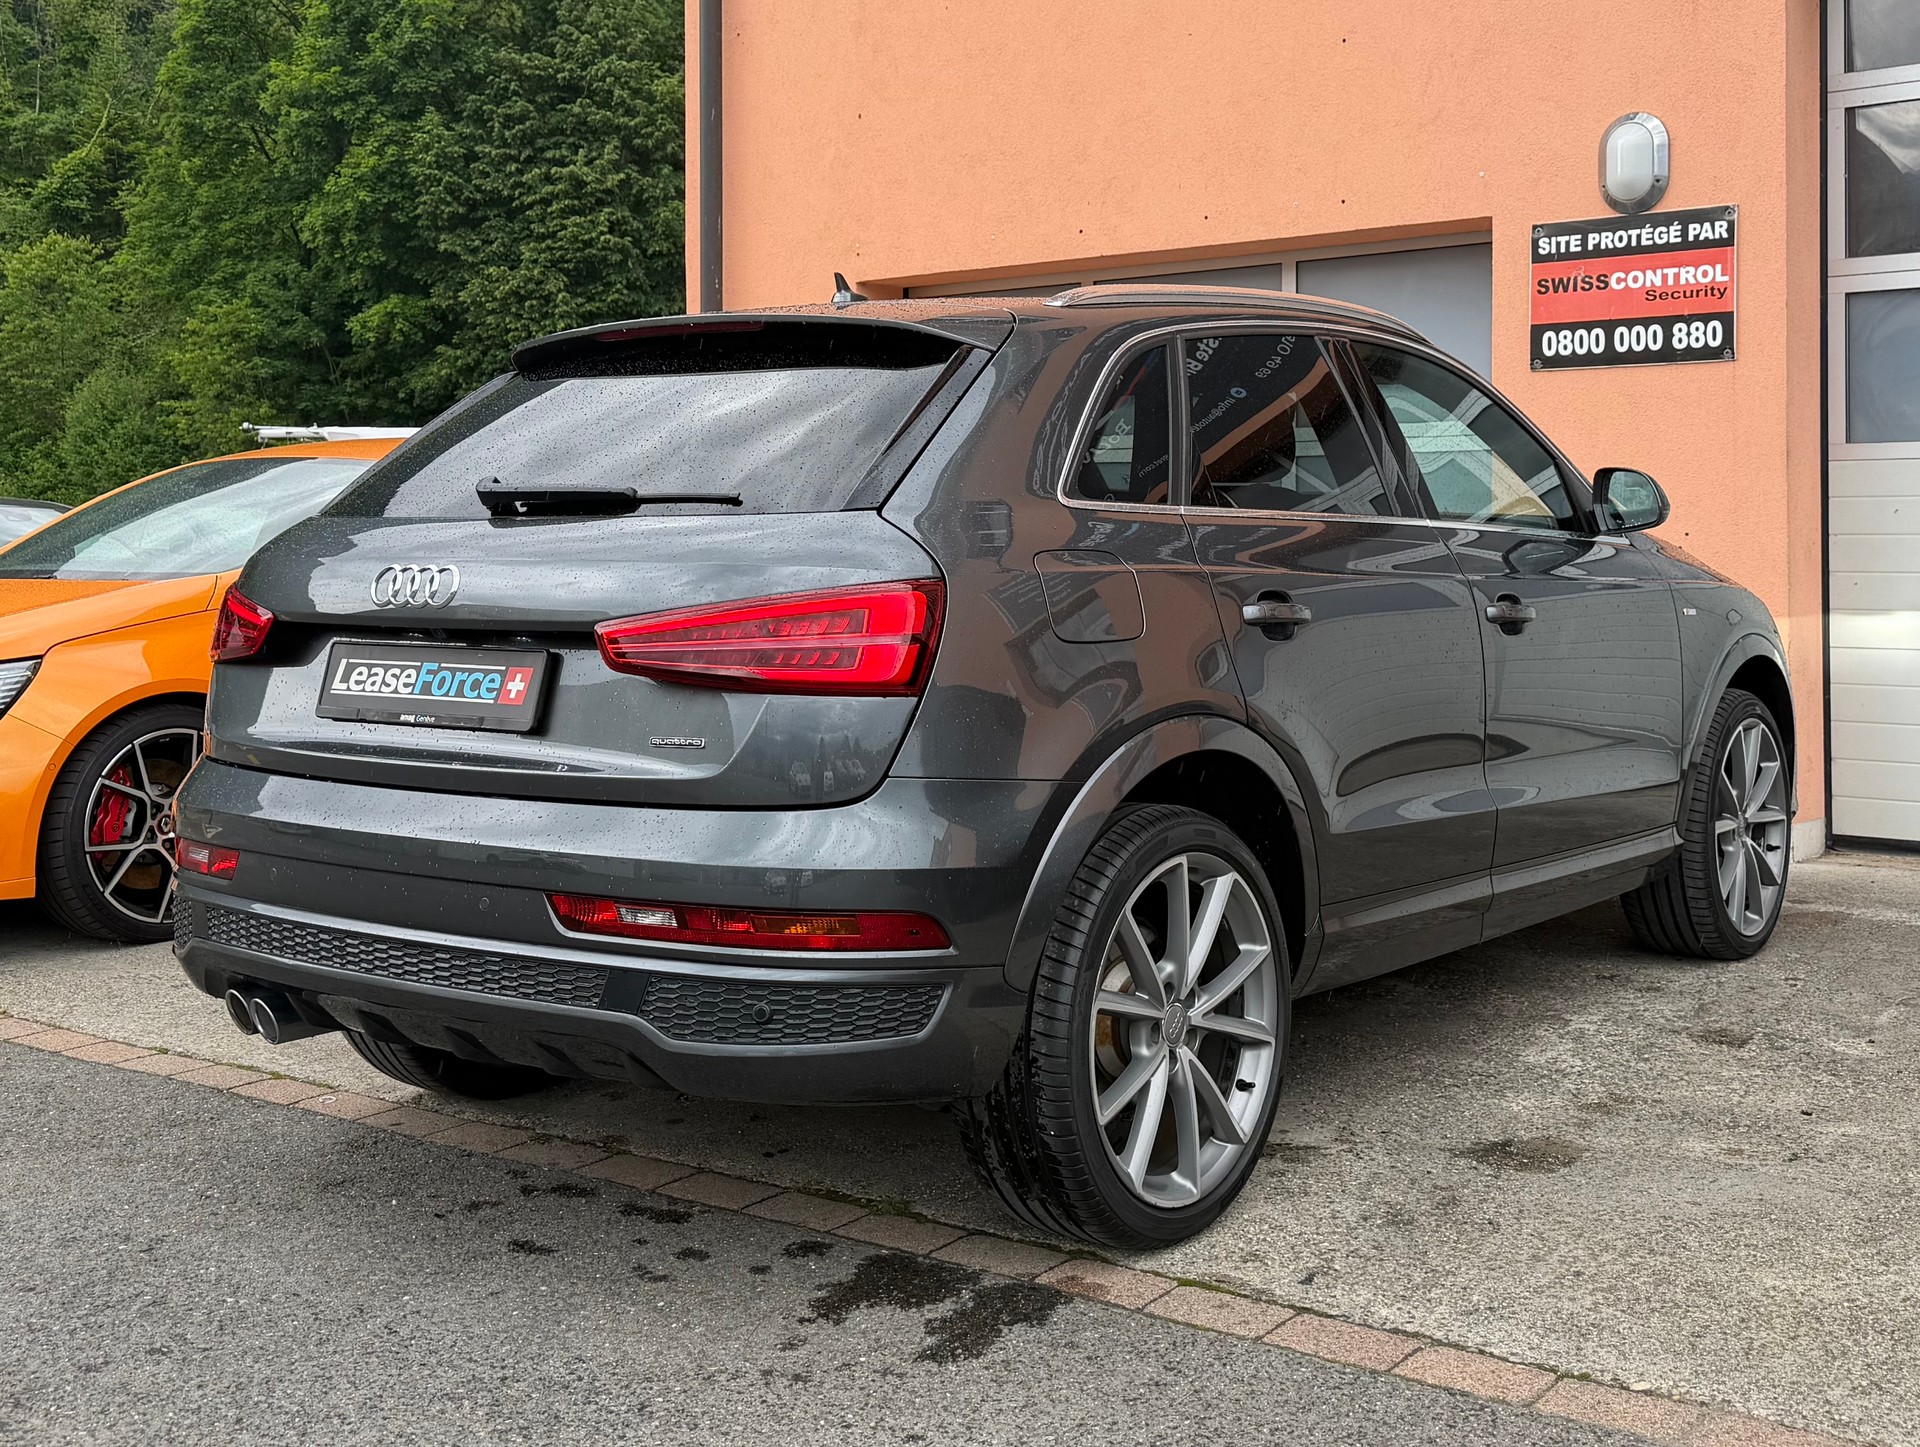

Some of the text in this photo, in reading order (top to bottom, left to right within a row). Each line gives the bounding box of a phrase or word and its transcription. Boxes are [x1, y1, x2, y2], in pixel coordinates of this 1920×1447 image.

[1538, 220, 1729, 255] SITE PROTÉGÉ PAR
[1644, 285, 1728, 301] Security
[1541, 320, 1724, 357] 0800 000 880
[330, 658, 502, 700] LeaseForce
[651, 737, 702, 747] quattro
